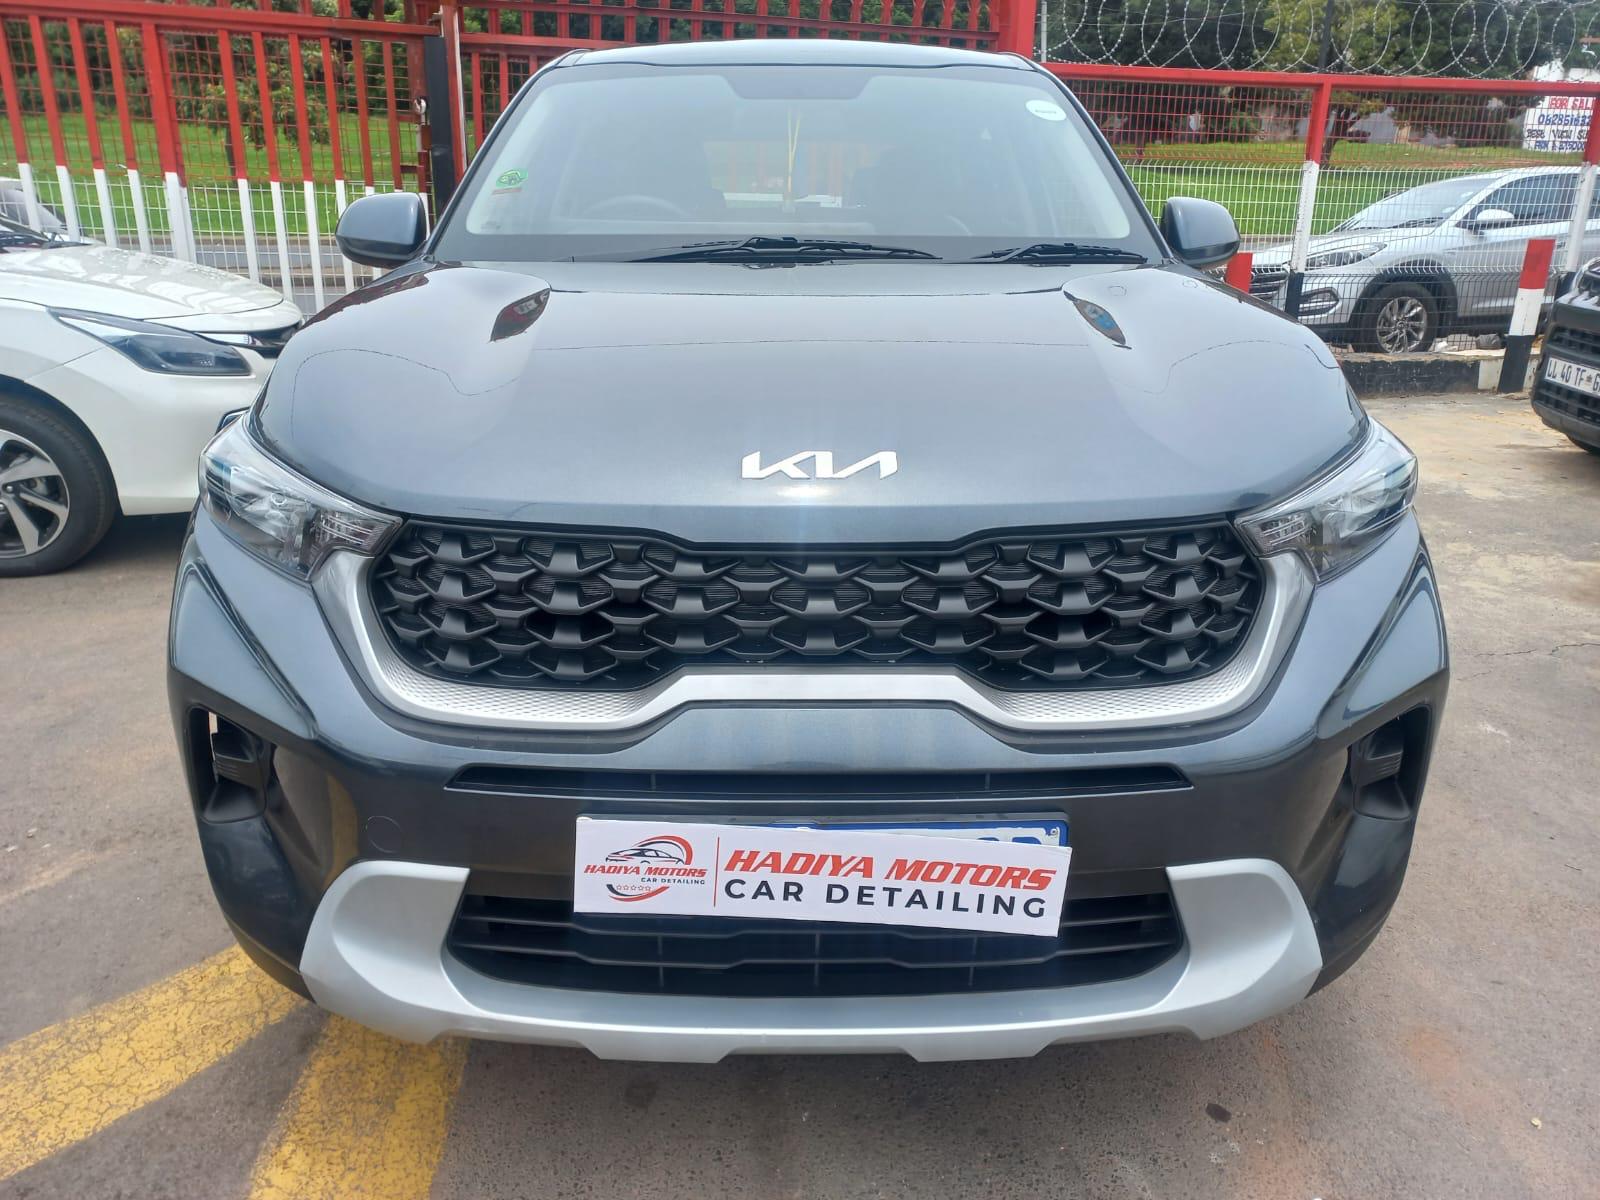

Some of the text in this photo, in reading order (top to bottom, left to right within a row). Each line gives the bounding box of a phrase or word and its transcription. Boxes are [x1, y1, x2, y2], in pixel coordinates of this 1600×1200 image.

[1549, 97, 1592, 109] FOR SAL
[1547, 359, 1600, 391] LL 40 TF G
[741, 450, 898, 480] KIA
[584, 864, 708, 877] HADIYA MOTORS
[724, 849, 1057, 891] HADIYA MOTORS
[724, 878, 1046, 919] CAR DETAILING
